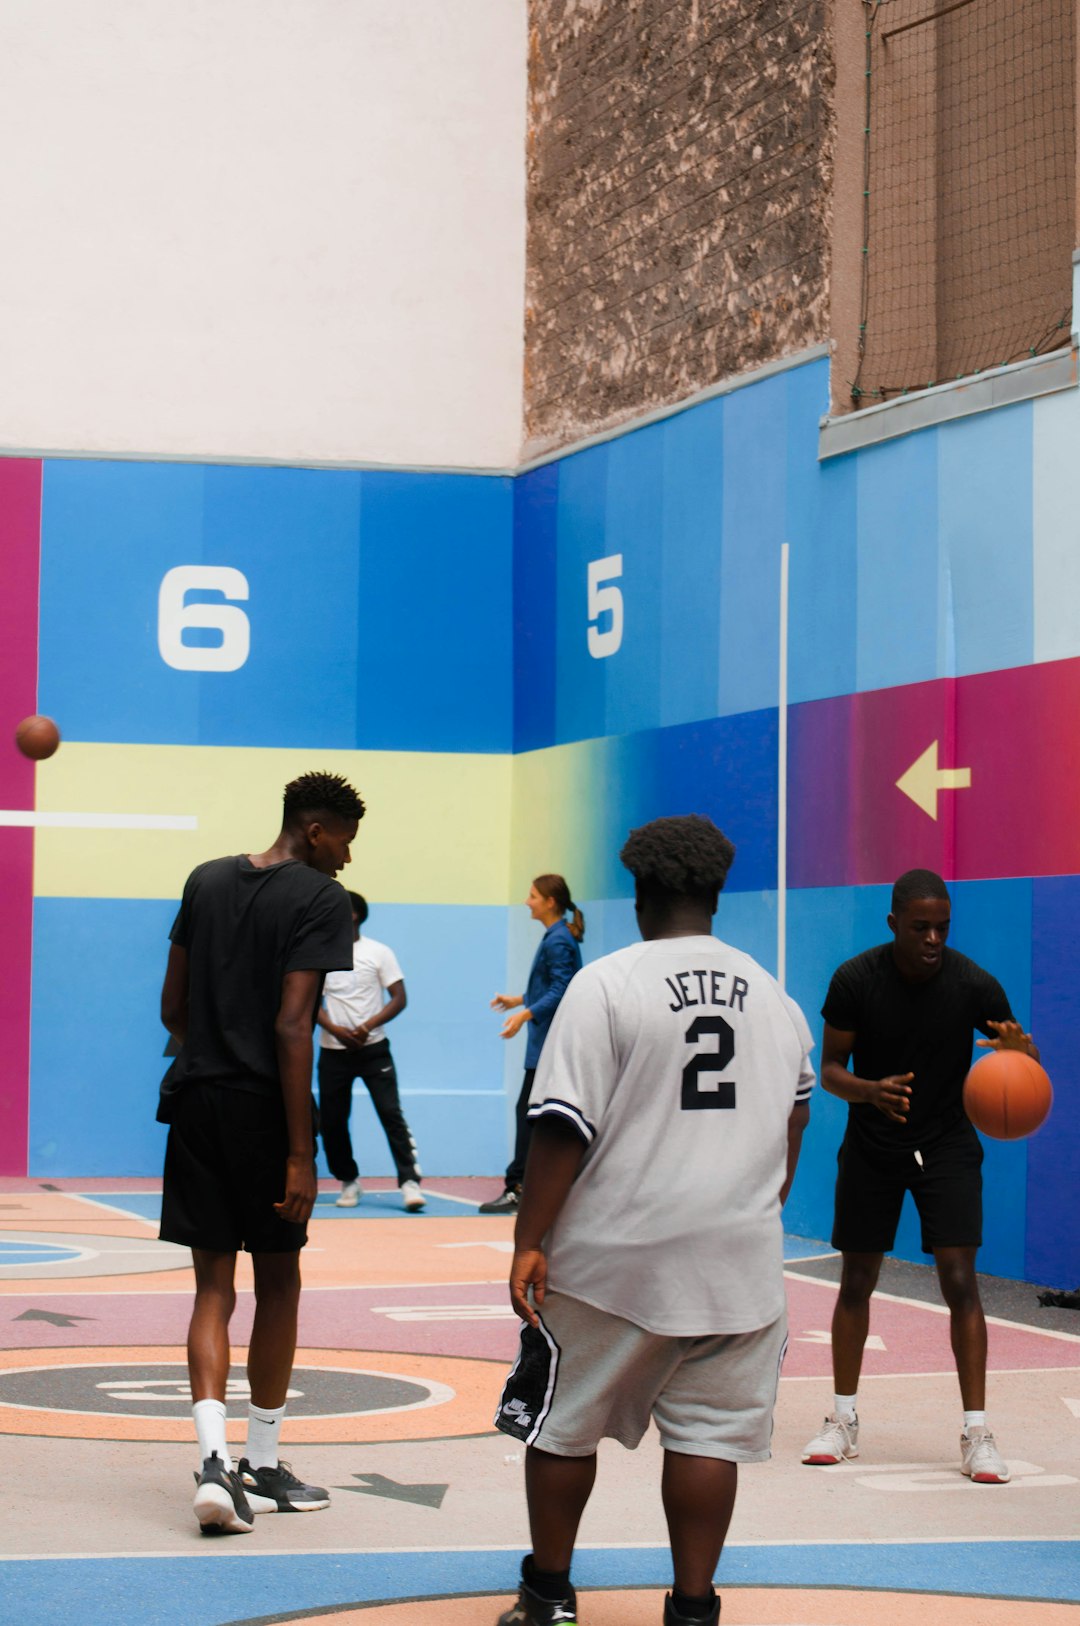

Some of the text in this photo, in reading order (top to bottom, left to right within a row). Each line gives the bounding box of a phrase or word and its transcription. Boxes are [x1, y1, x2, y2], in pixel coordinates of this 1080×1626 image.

[158, 565, 250, 672] 6
[587, 553, 624, 659] 5
[665, 970, 749, 1013] JETER
[681, 1016, 736, 1111] 2
